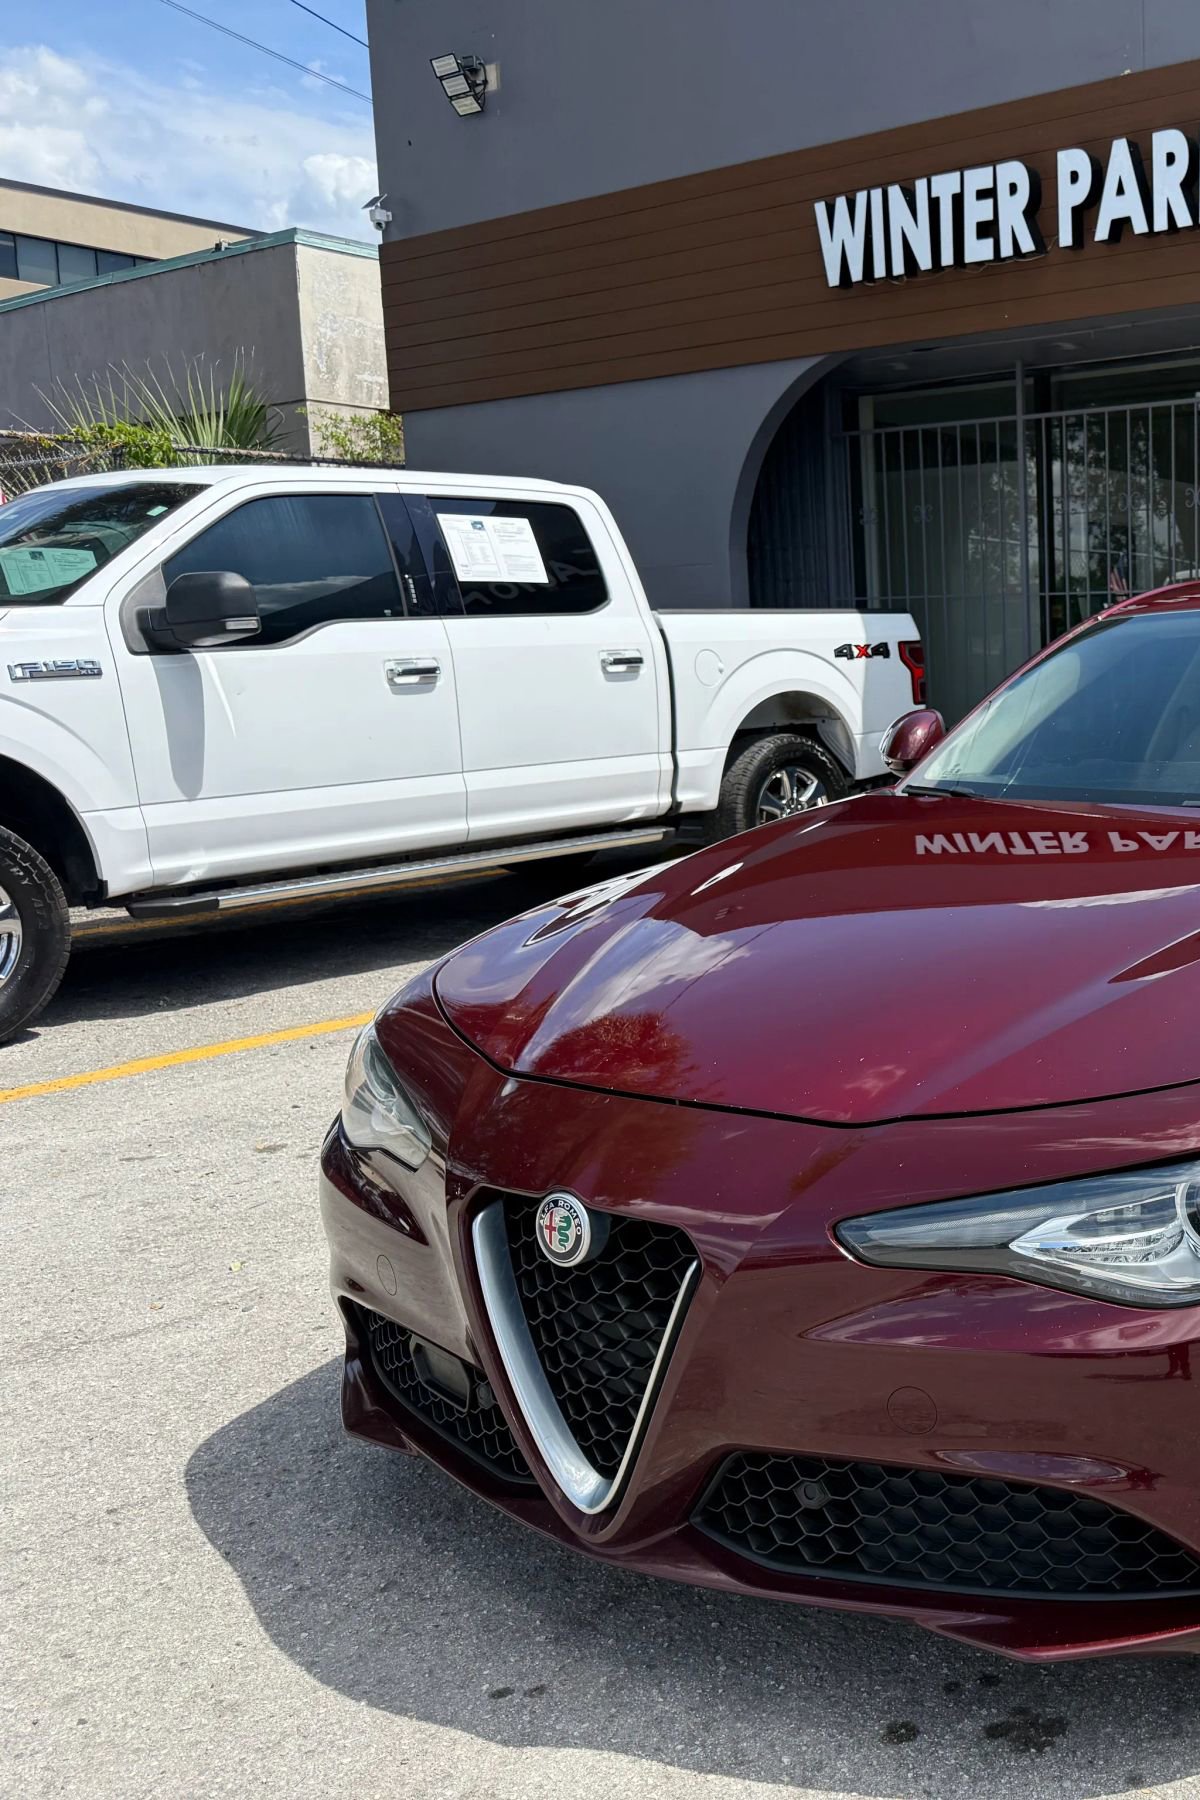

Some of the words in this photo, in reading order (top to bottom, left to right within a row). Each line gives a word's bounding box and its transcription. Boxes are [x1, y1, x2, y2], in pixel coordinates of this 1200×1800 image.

[814, 161, 1036, 287] WINTER
[80, 667, 99, 675] XLT
[540, 1202, 555, 1226] ALFA
[558, 1200, 582, 1235] ROMEO
